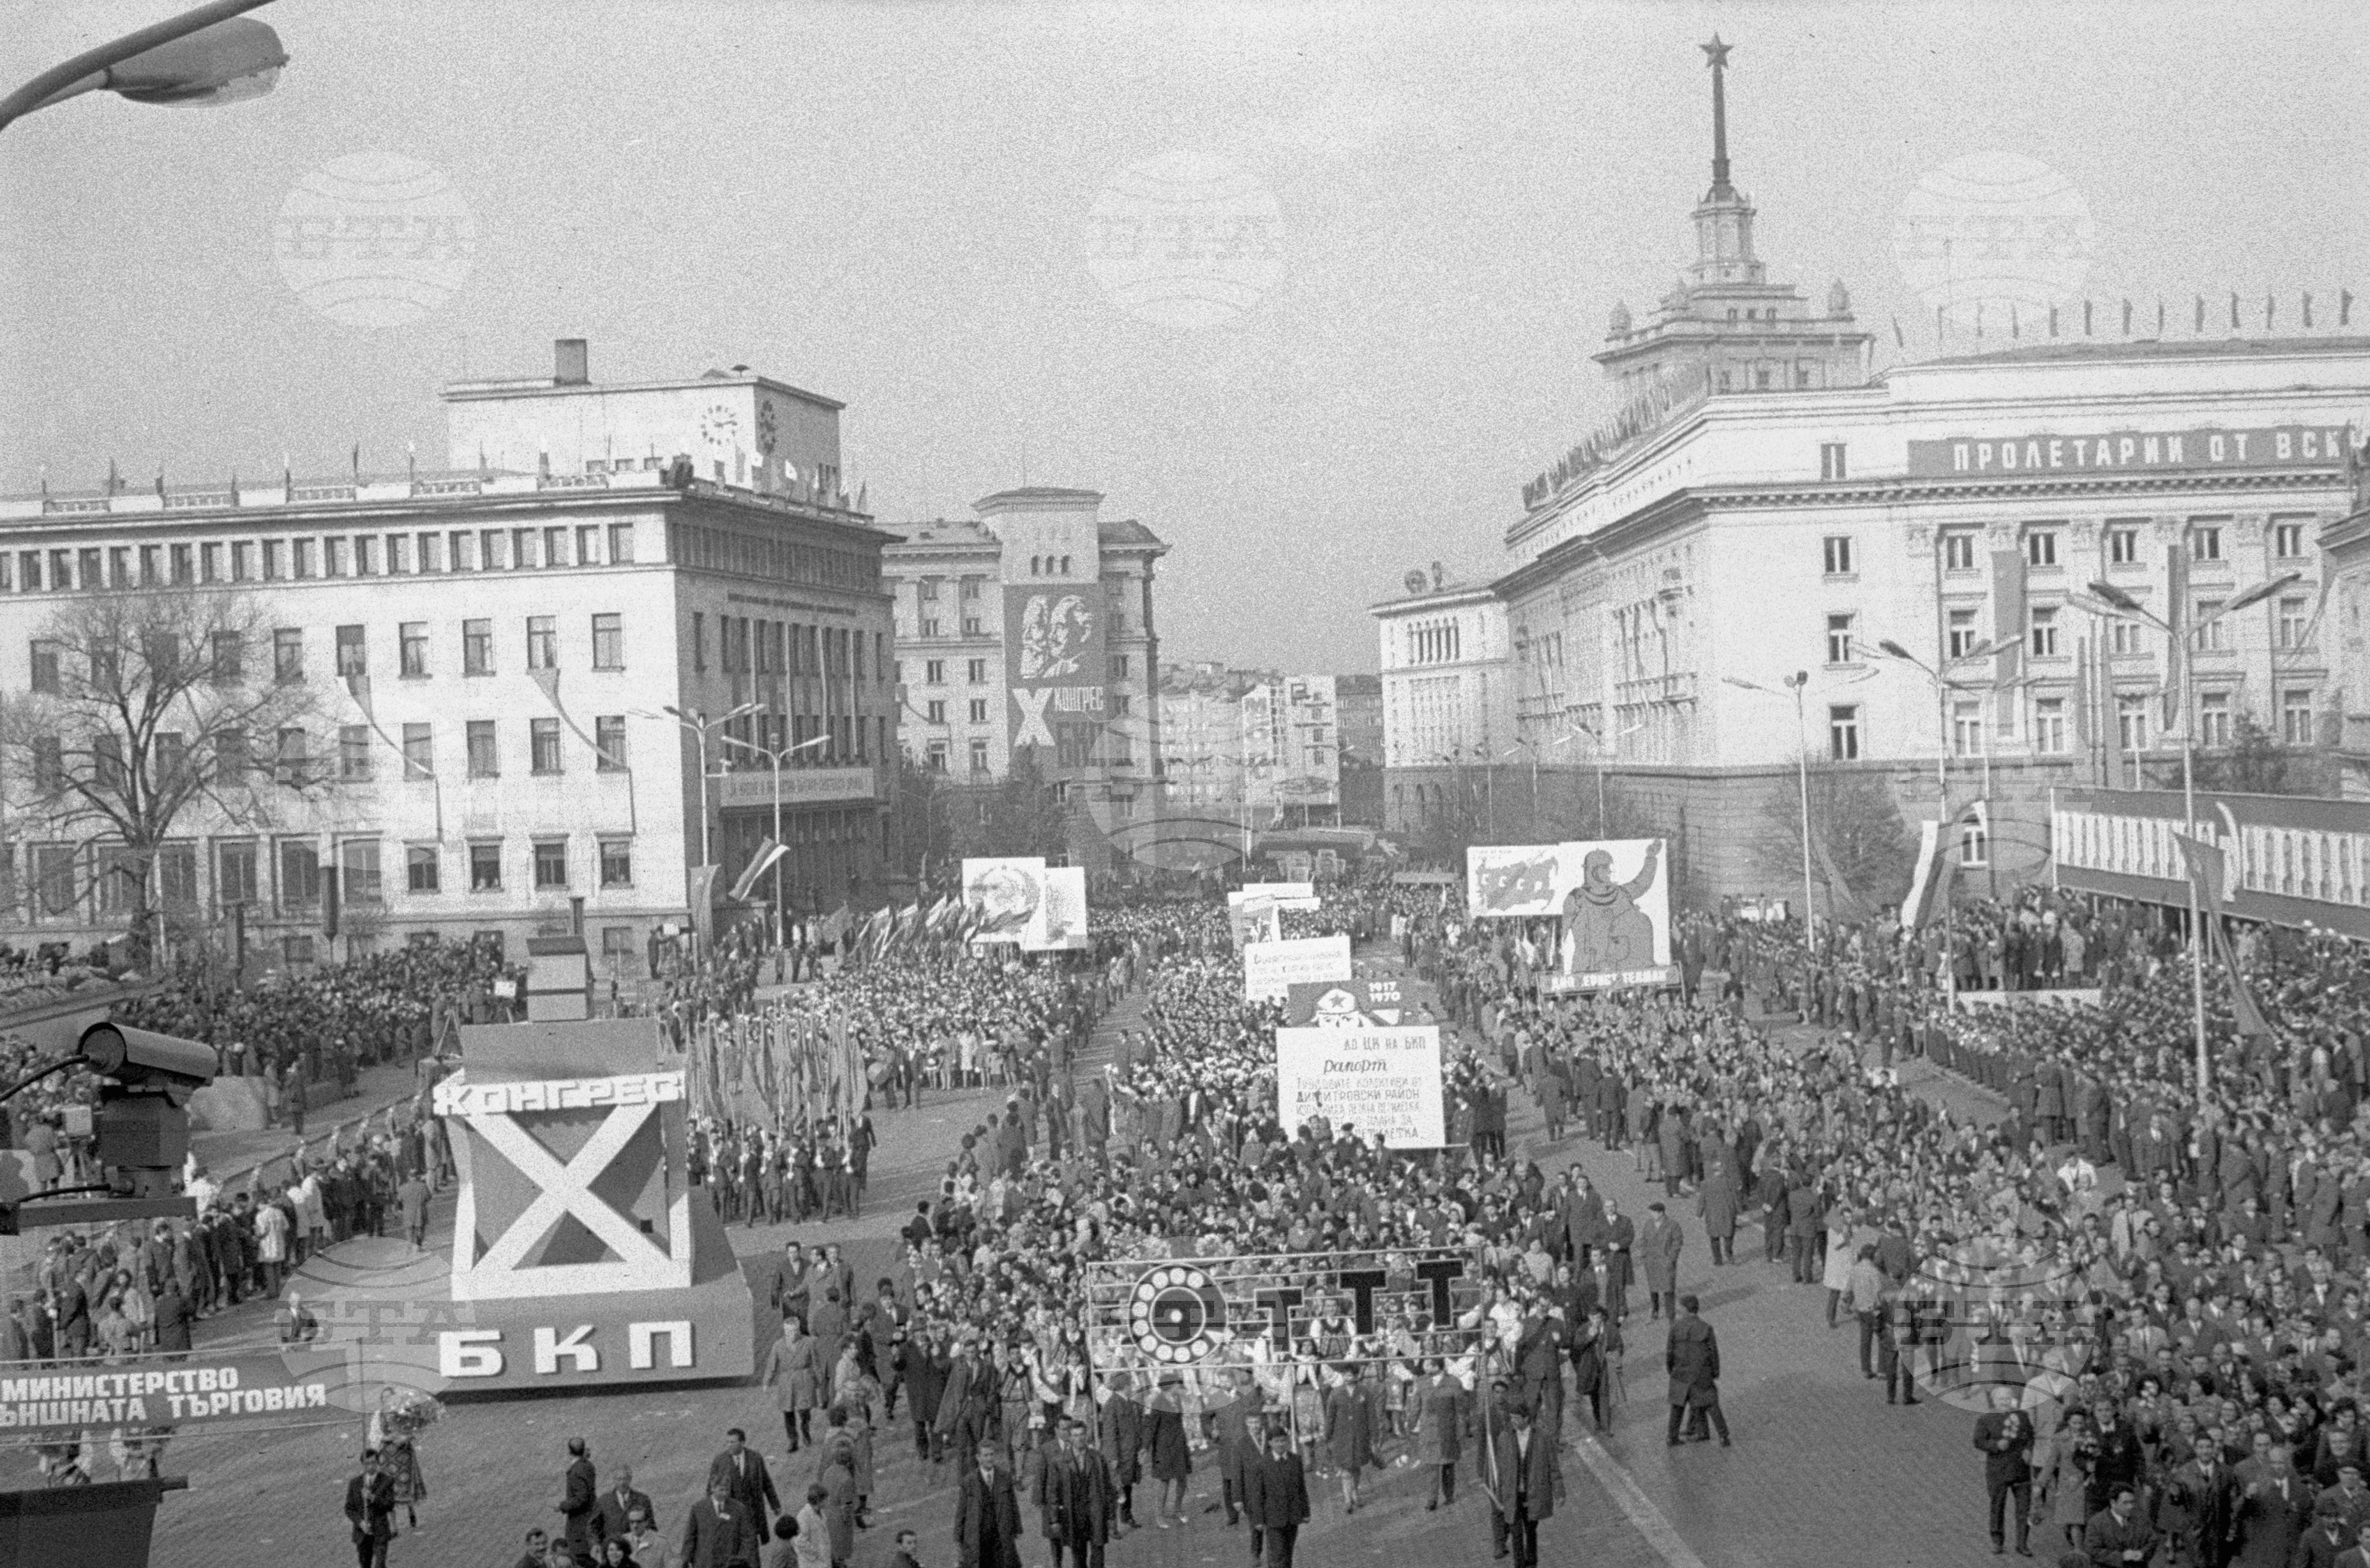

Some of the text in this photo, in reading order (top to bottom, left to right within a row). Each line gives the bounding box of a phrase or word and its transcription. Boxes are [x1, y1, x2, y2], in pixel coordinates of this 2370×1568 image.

[1953, 436, 2183, 472] ПРОЛЕТАРИИ
[2210, 434, 2249, 461] ОТ
[1055, 687, 1104, 711] КОНГРЕС
[1481, 874, 1543, 892] СССР
[1369, 981, 1397, 992] 1917
[1369, 991, 1401, 1002] 1970
[1385, 1038, 1398, 1050] НА
[434, 1070, 686, 1116] КОНГРЕС
[439, 1321, 693, 1377] БКП
[1, 1366, 239, 1402] МИНИСТЕРСТВО
[167, 1383, 326, 1419] ТЪРГОВИЯ
